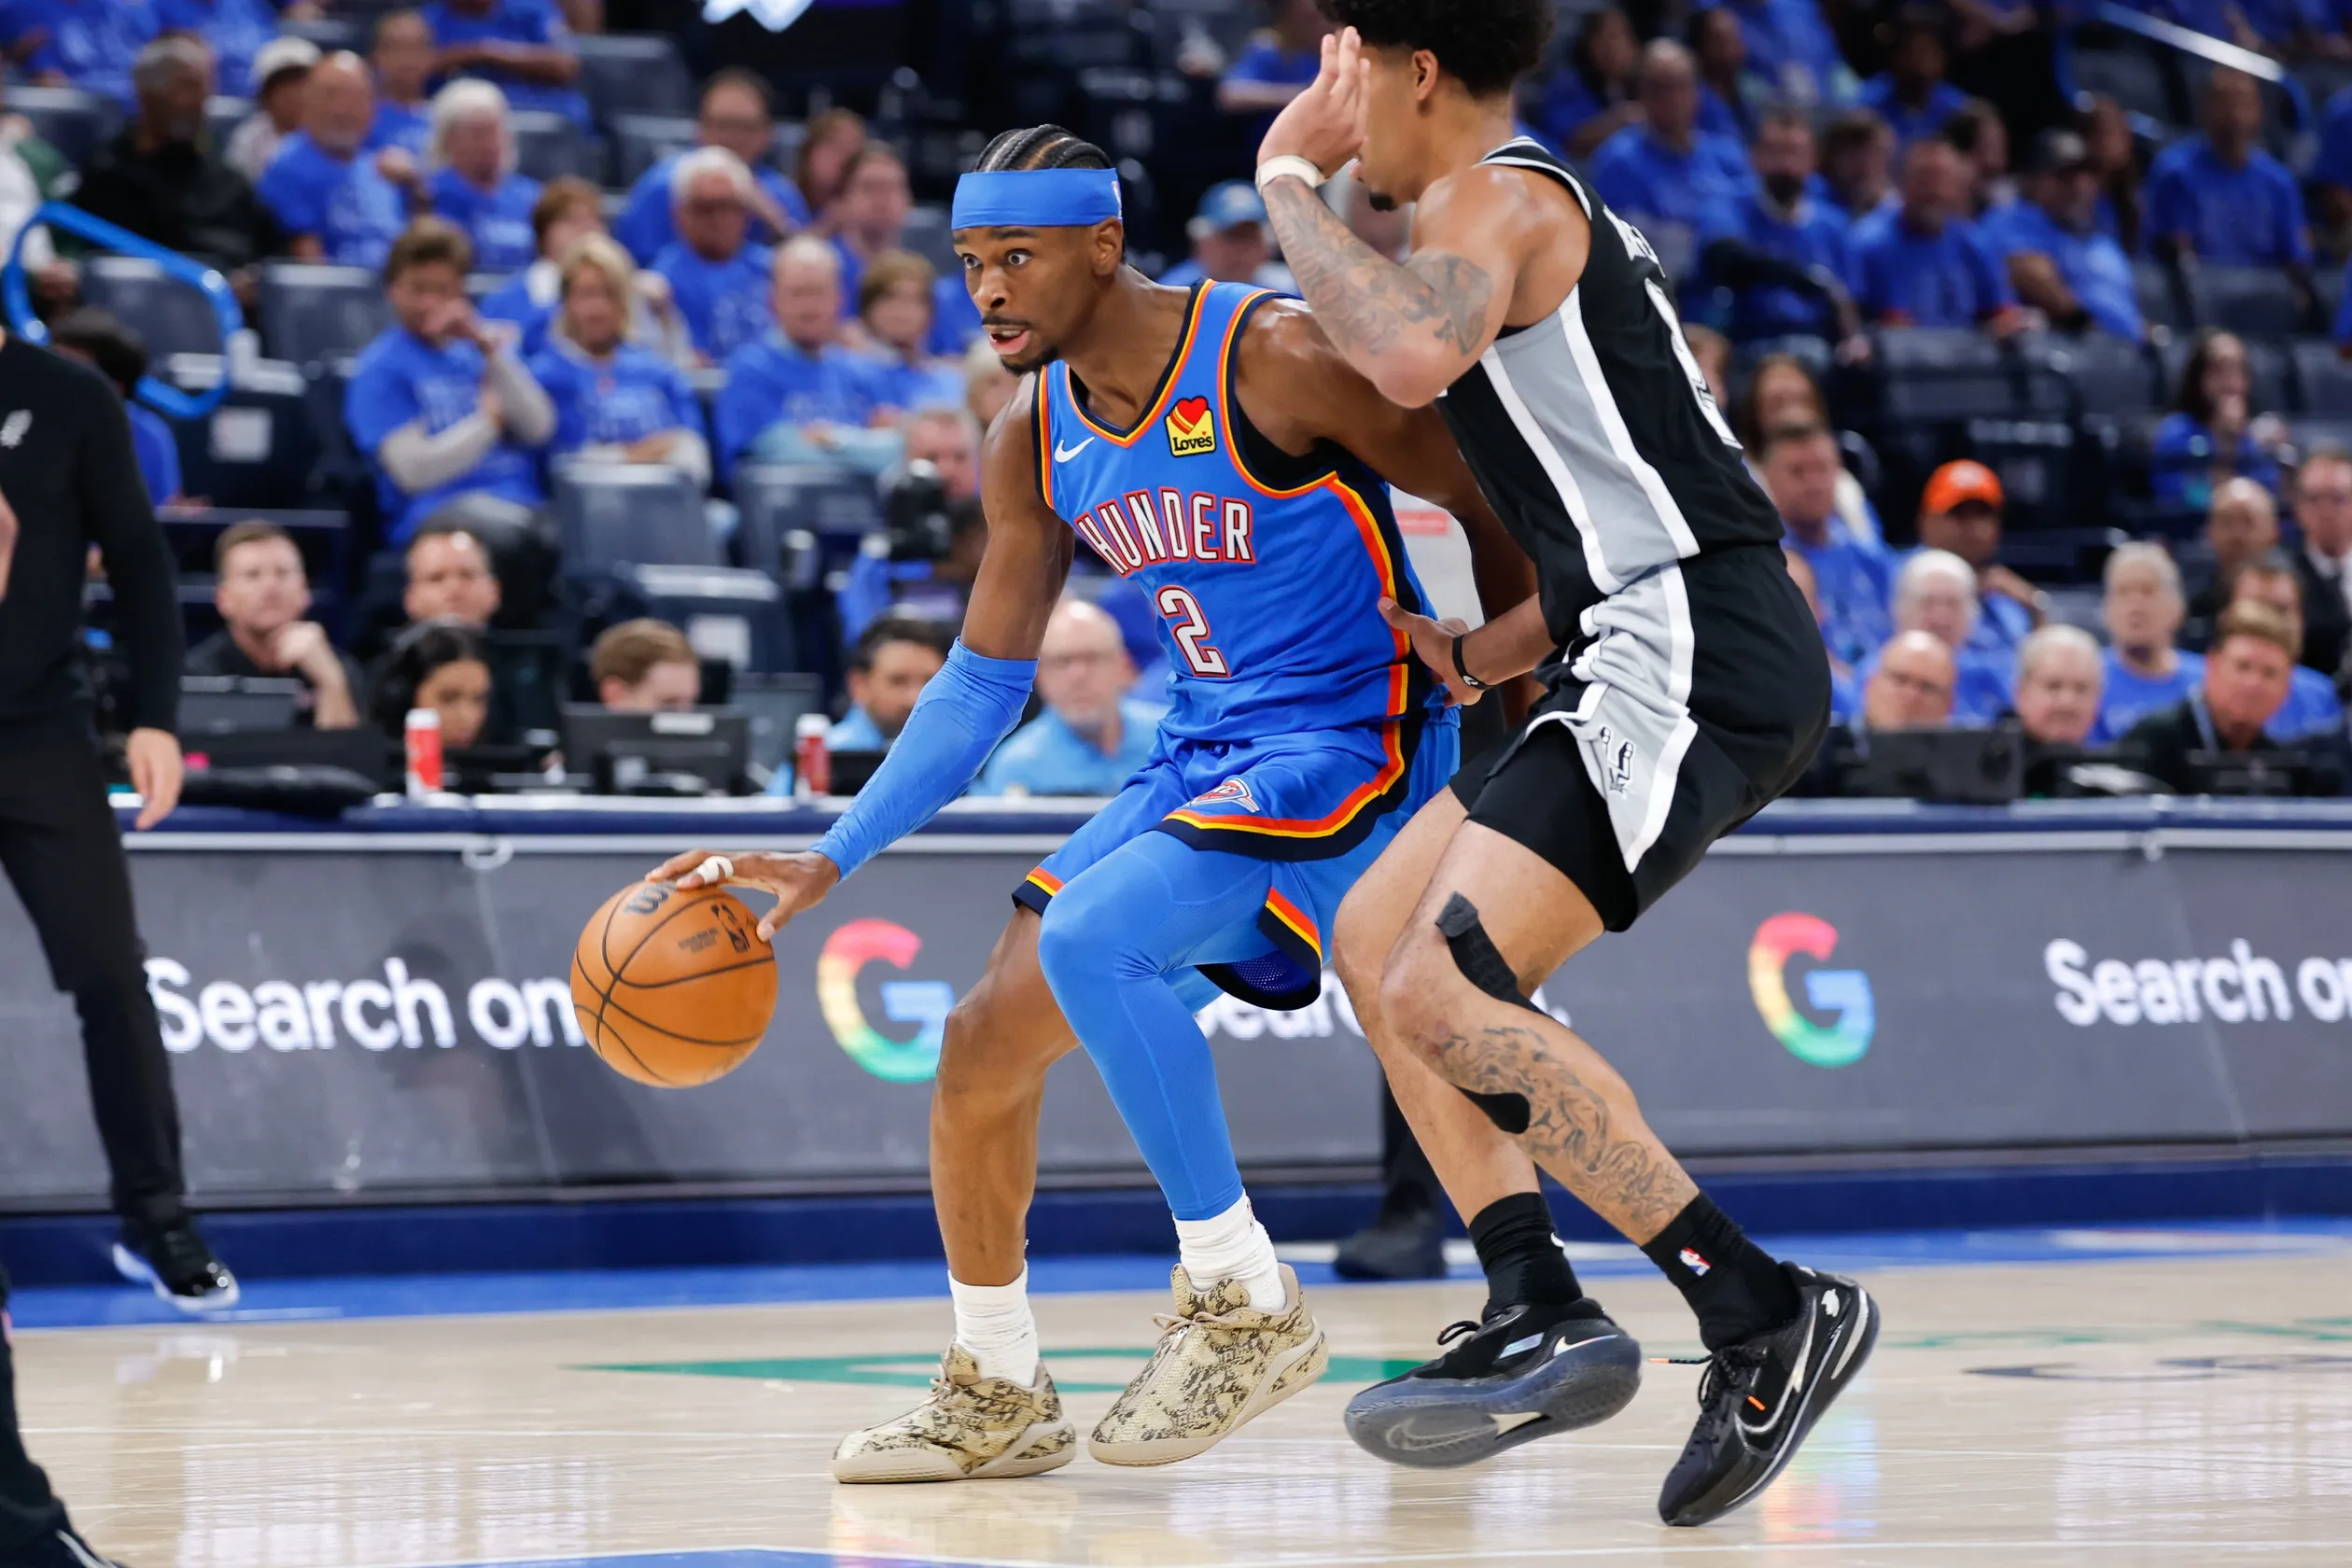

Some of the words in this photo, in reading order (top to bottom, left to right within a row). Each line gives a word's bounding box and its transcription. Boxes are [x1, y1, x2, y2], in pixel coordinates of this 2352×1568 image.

[1073, 486, 1256, 579] HUNDER
[1155, 585, 1231, 678] 2
[144, 957, 457, 1053] Search
[468, 977, 587, 1051] on
[2044, 937, 2294, 1027] Search
